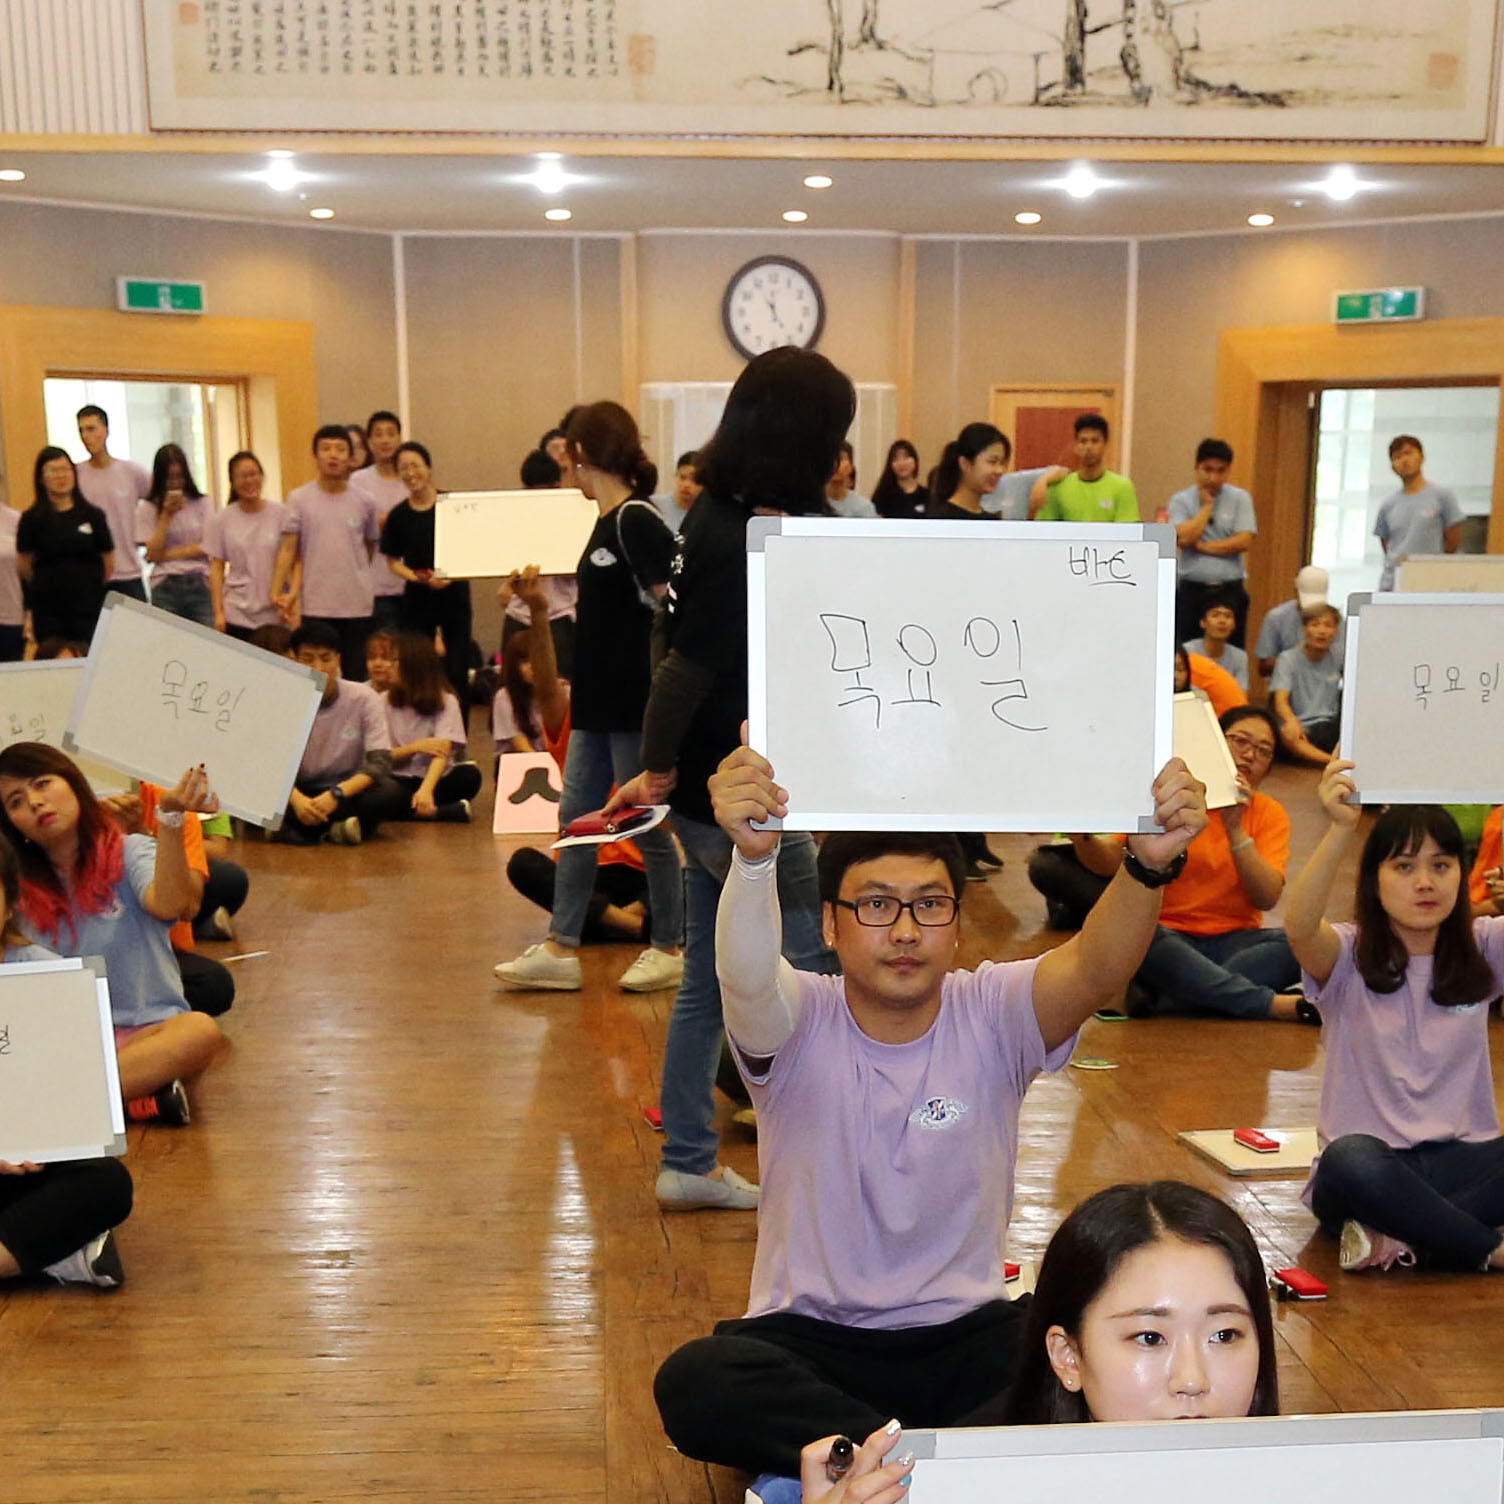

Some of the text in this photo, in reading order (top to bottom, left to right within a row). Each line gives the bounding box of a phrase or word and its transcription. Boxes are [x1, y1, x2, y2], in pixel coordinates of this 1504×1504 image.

[161, 659, 246, 733] 목요일
[820, 613, 1048, 732] 목요일
[1414, 662, 1500, 710] 목요일
